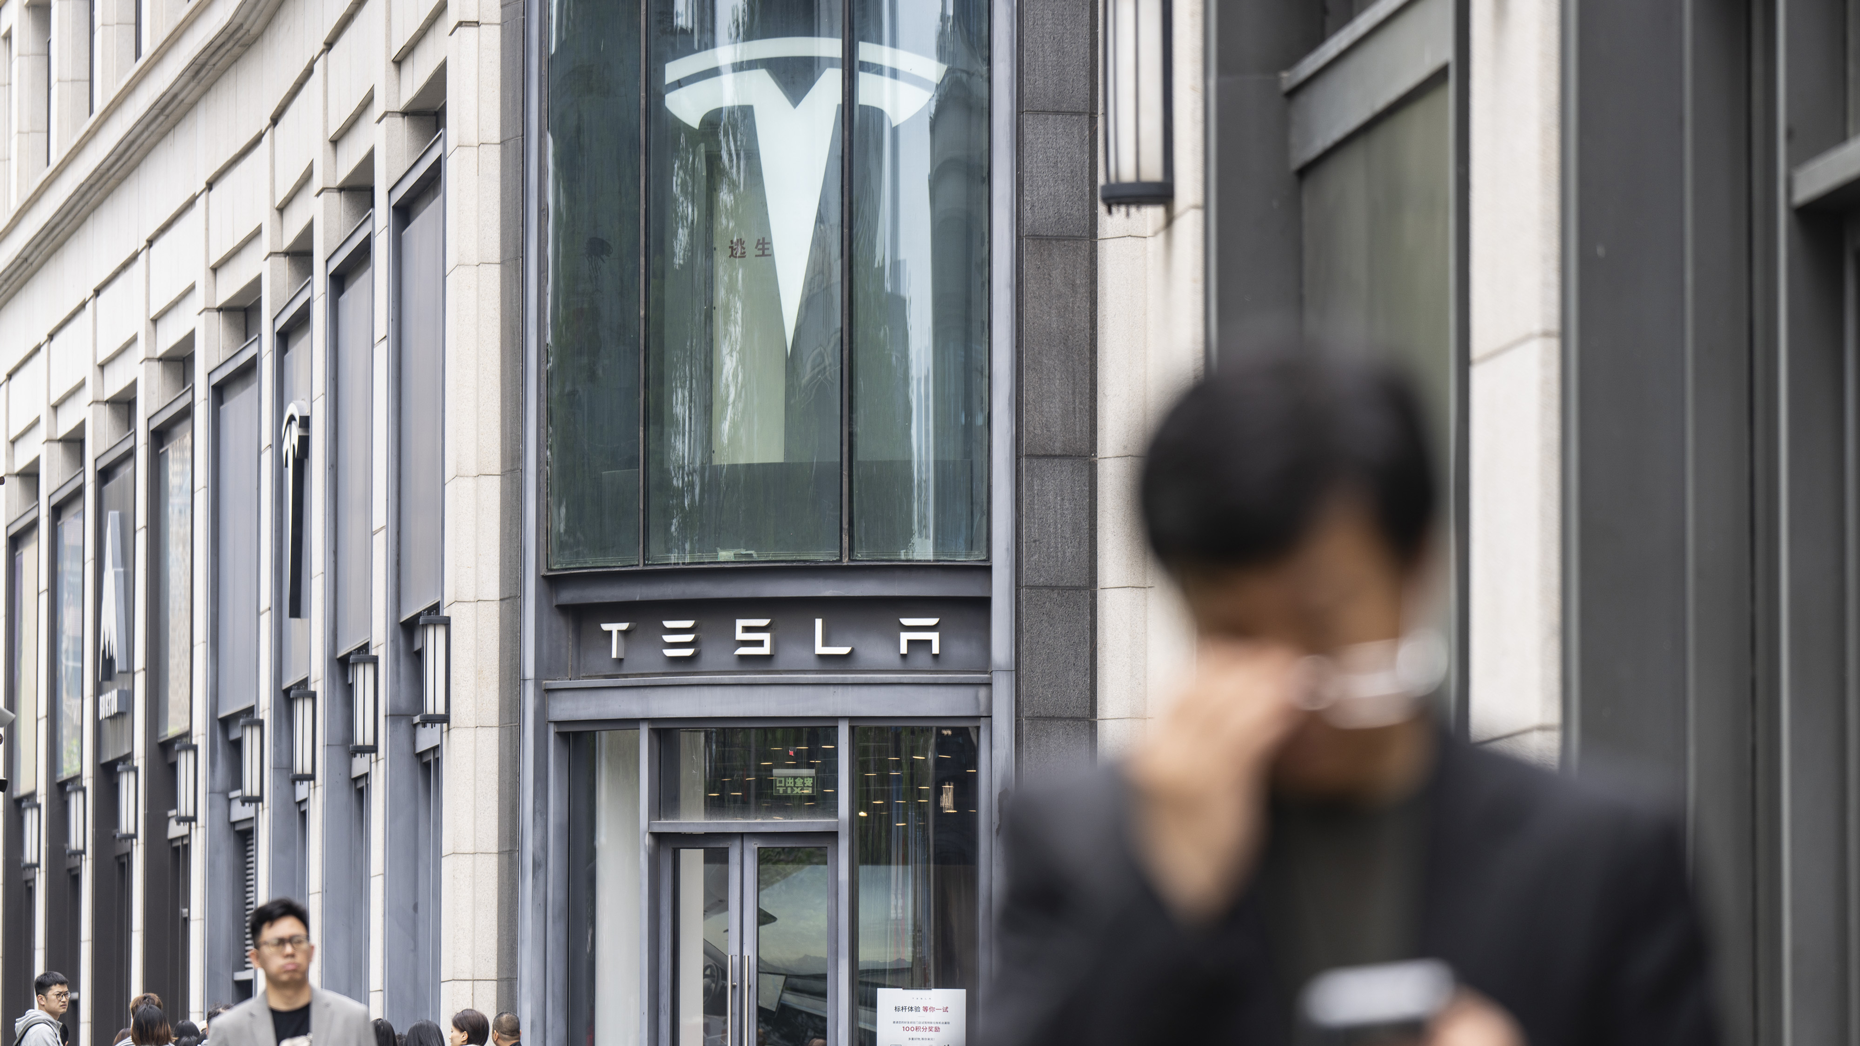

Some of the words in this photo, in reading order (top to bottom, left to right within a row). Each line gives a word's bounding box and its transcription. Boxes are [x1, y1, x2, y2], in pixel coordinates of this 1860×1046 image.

[728, 238, 772, 258] 逃生
[600, 617, 940, 660] TESLA
[922, 1005, 949, 1013] 等你一试
